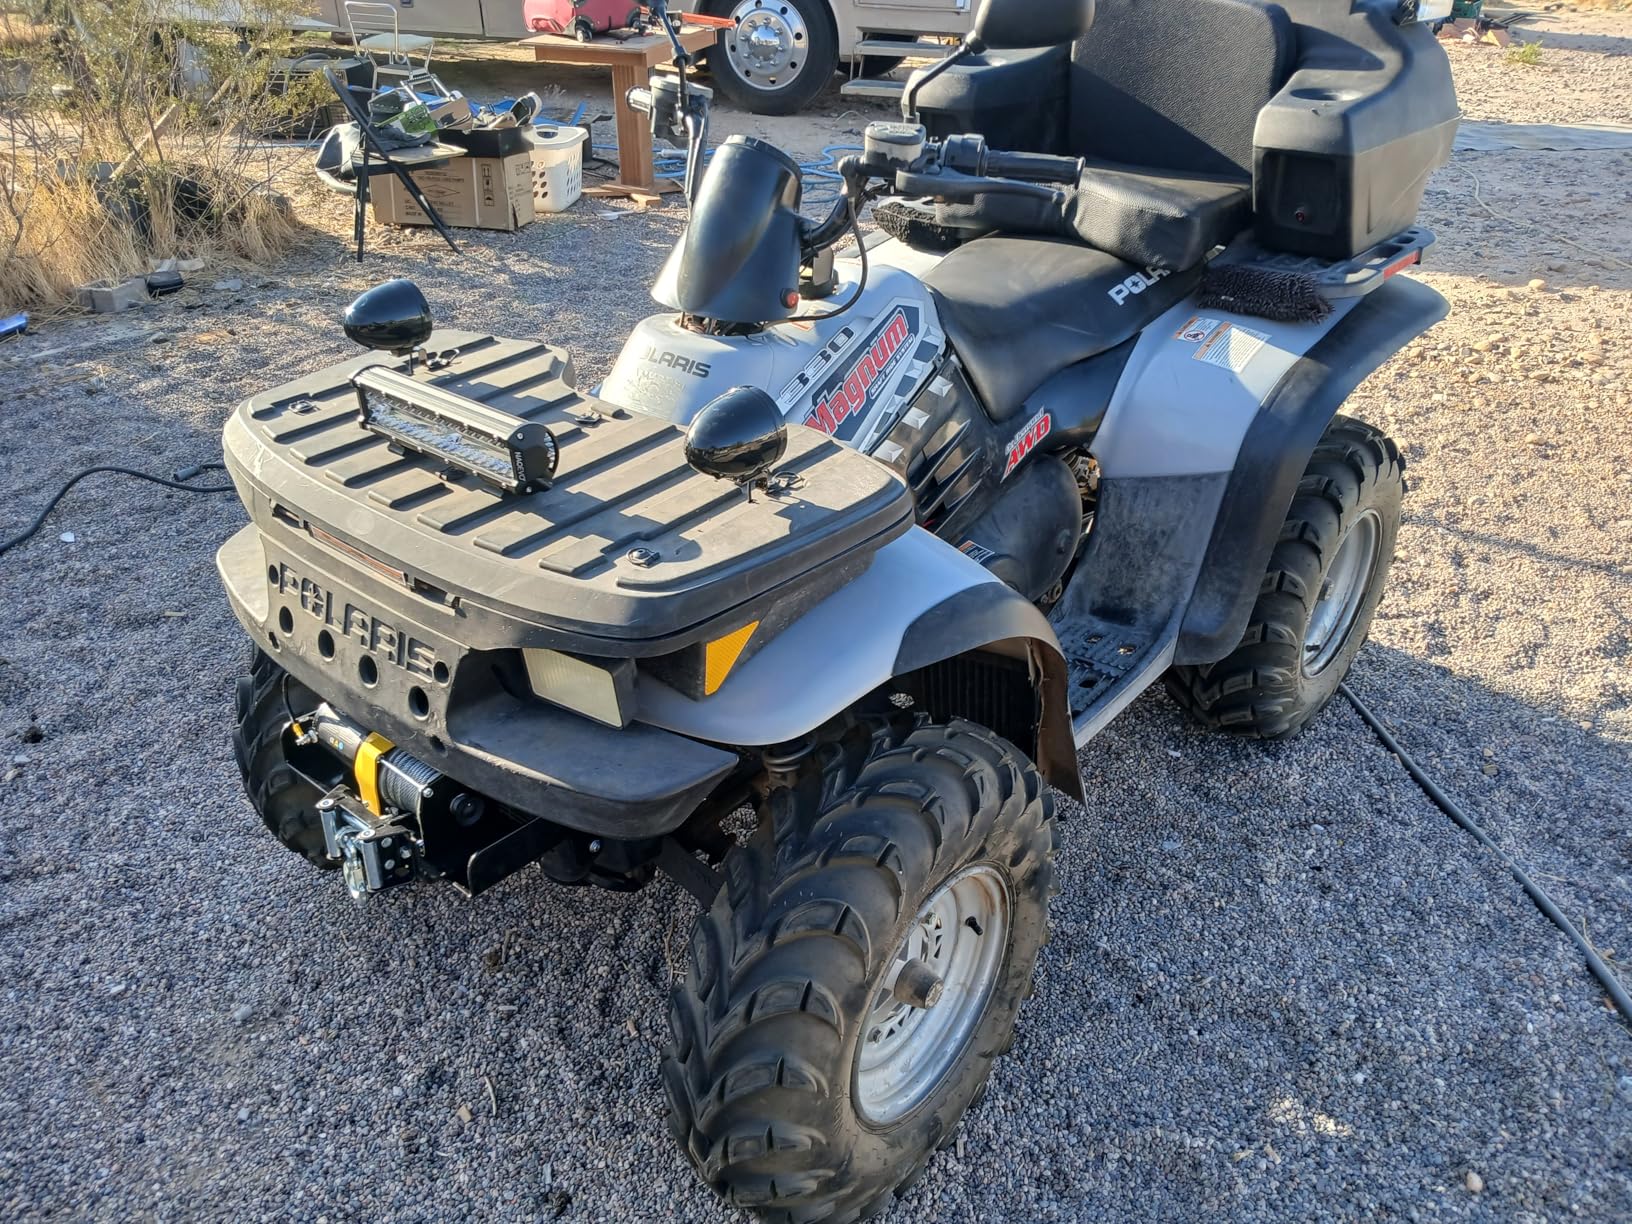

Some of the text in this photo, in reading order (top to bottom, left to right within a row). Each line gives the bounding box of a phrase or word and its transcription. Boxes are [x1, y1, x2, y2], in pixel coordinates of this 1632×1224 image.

[780, 326, 856, 405] 330
[803, 312, 909, 436] Magnum
[1000, 412, 1052, 484] AWD
[279, 561, 438, 684] POLARIS
